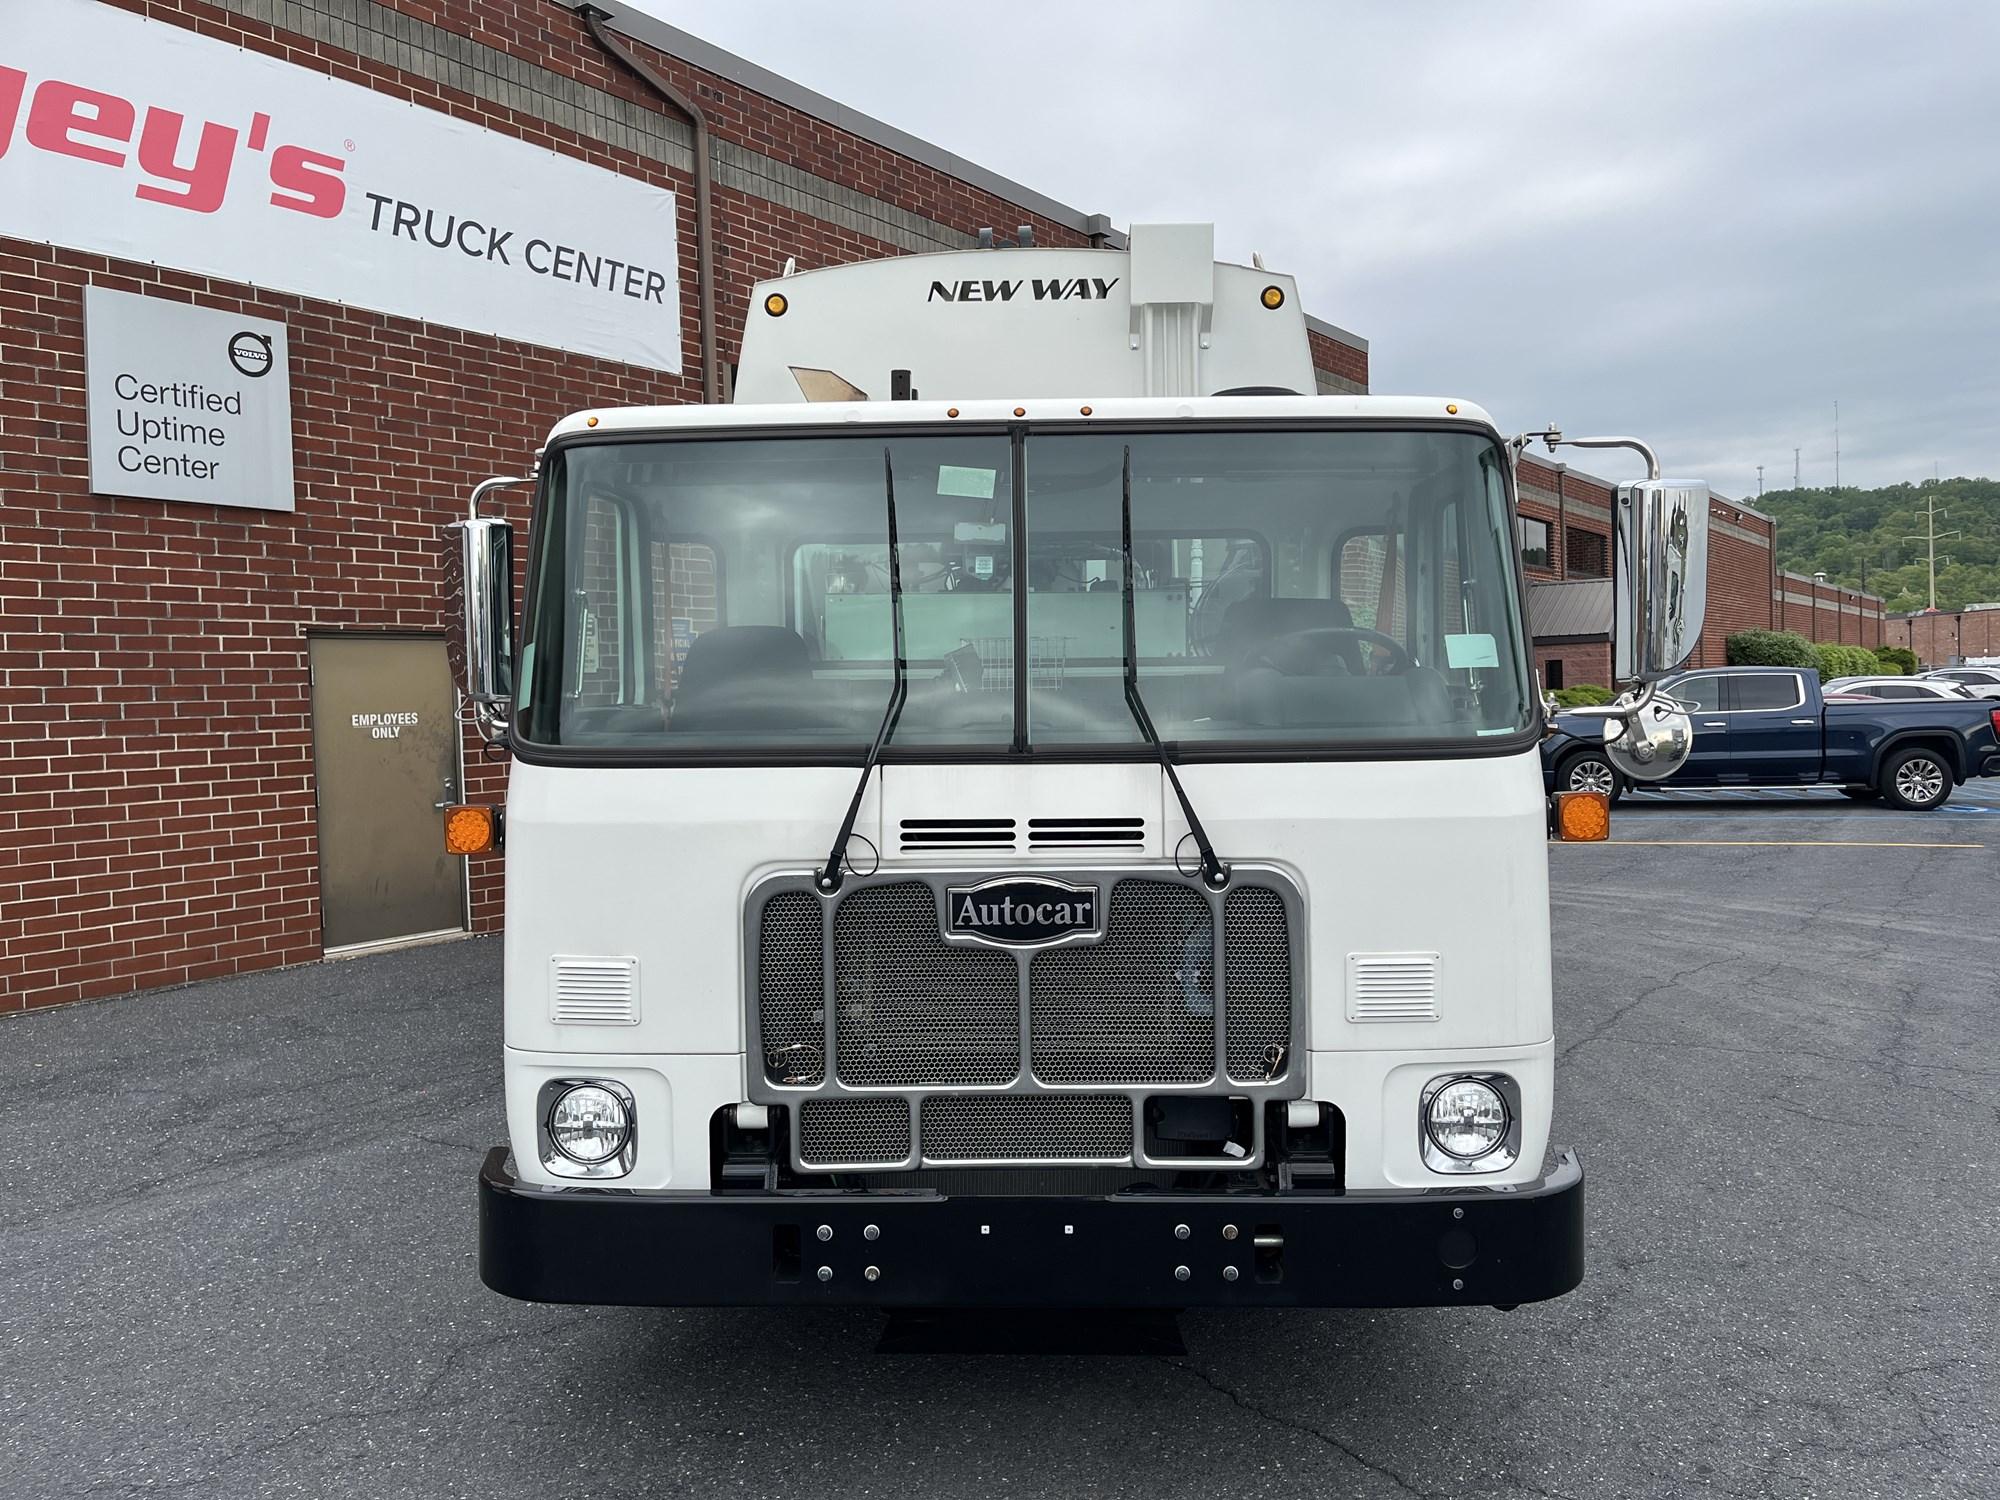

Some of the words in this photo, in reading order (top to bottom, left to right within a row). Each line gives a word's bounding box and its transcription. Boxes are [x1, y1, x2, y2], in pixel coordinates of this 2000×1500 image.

[0, 65, 346, 219] ey's
[365, 192, 514, 266] TRUCK
[524, 239, 666, 304] CENTER
[927, 279, 1024, 303] NEW
[1031, 277, 1121, 301] WAY
[233, 349, 268, 361] VOLVO
[114, 373, 241, 416] Certified
[117, 408, 225, 447] Uptime
[118, 445, 220, 480] Center
[351, 712, 419, 727] EMPLOYEES
[371, 726, 401, 739] ONLY
[954, 895, 1092, 926] Autocar
